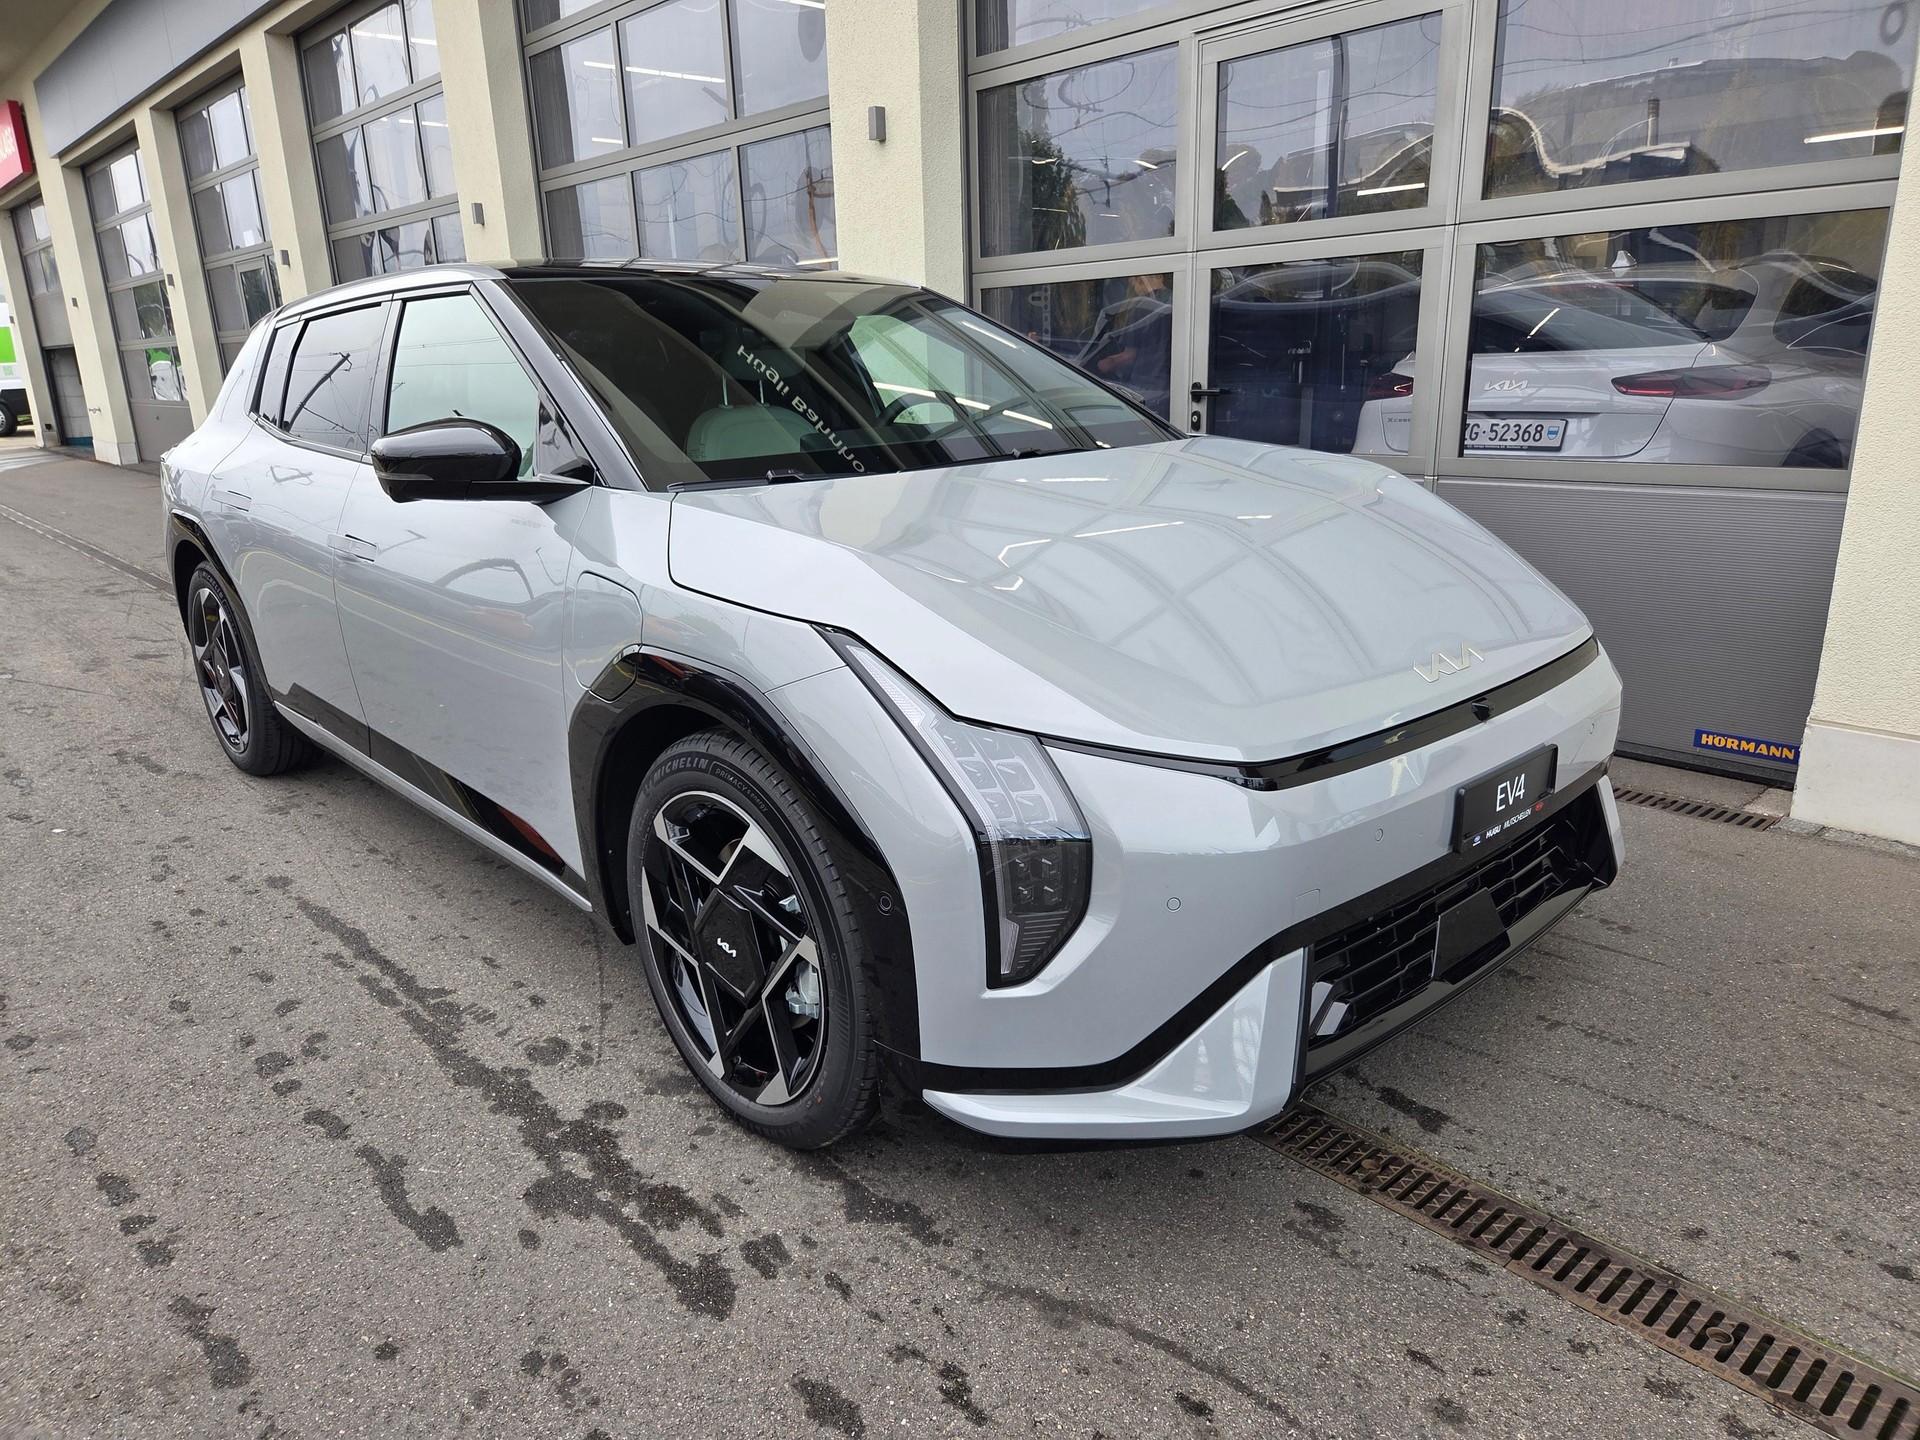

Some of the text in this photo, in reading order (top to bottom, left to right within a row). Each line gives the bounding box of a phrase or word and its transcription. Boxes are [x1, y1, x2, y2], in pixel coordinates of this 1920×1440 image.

[1483, 380, 1529, 392] KIA
[1413, 641, 1484, 684] KIA
[1701, 732, 1795, 760] HÖRMANN
[653, 757, 709, 784] MICHELIN
[716, 768, 748, 791] PRIMACY
[1496, 773, 1525, 812] EV4
